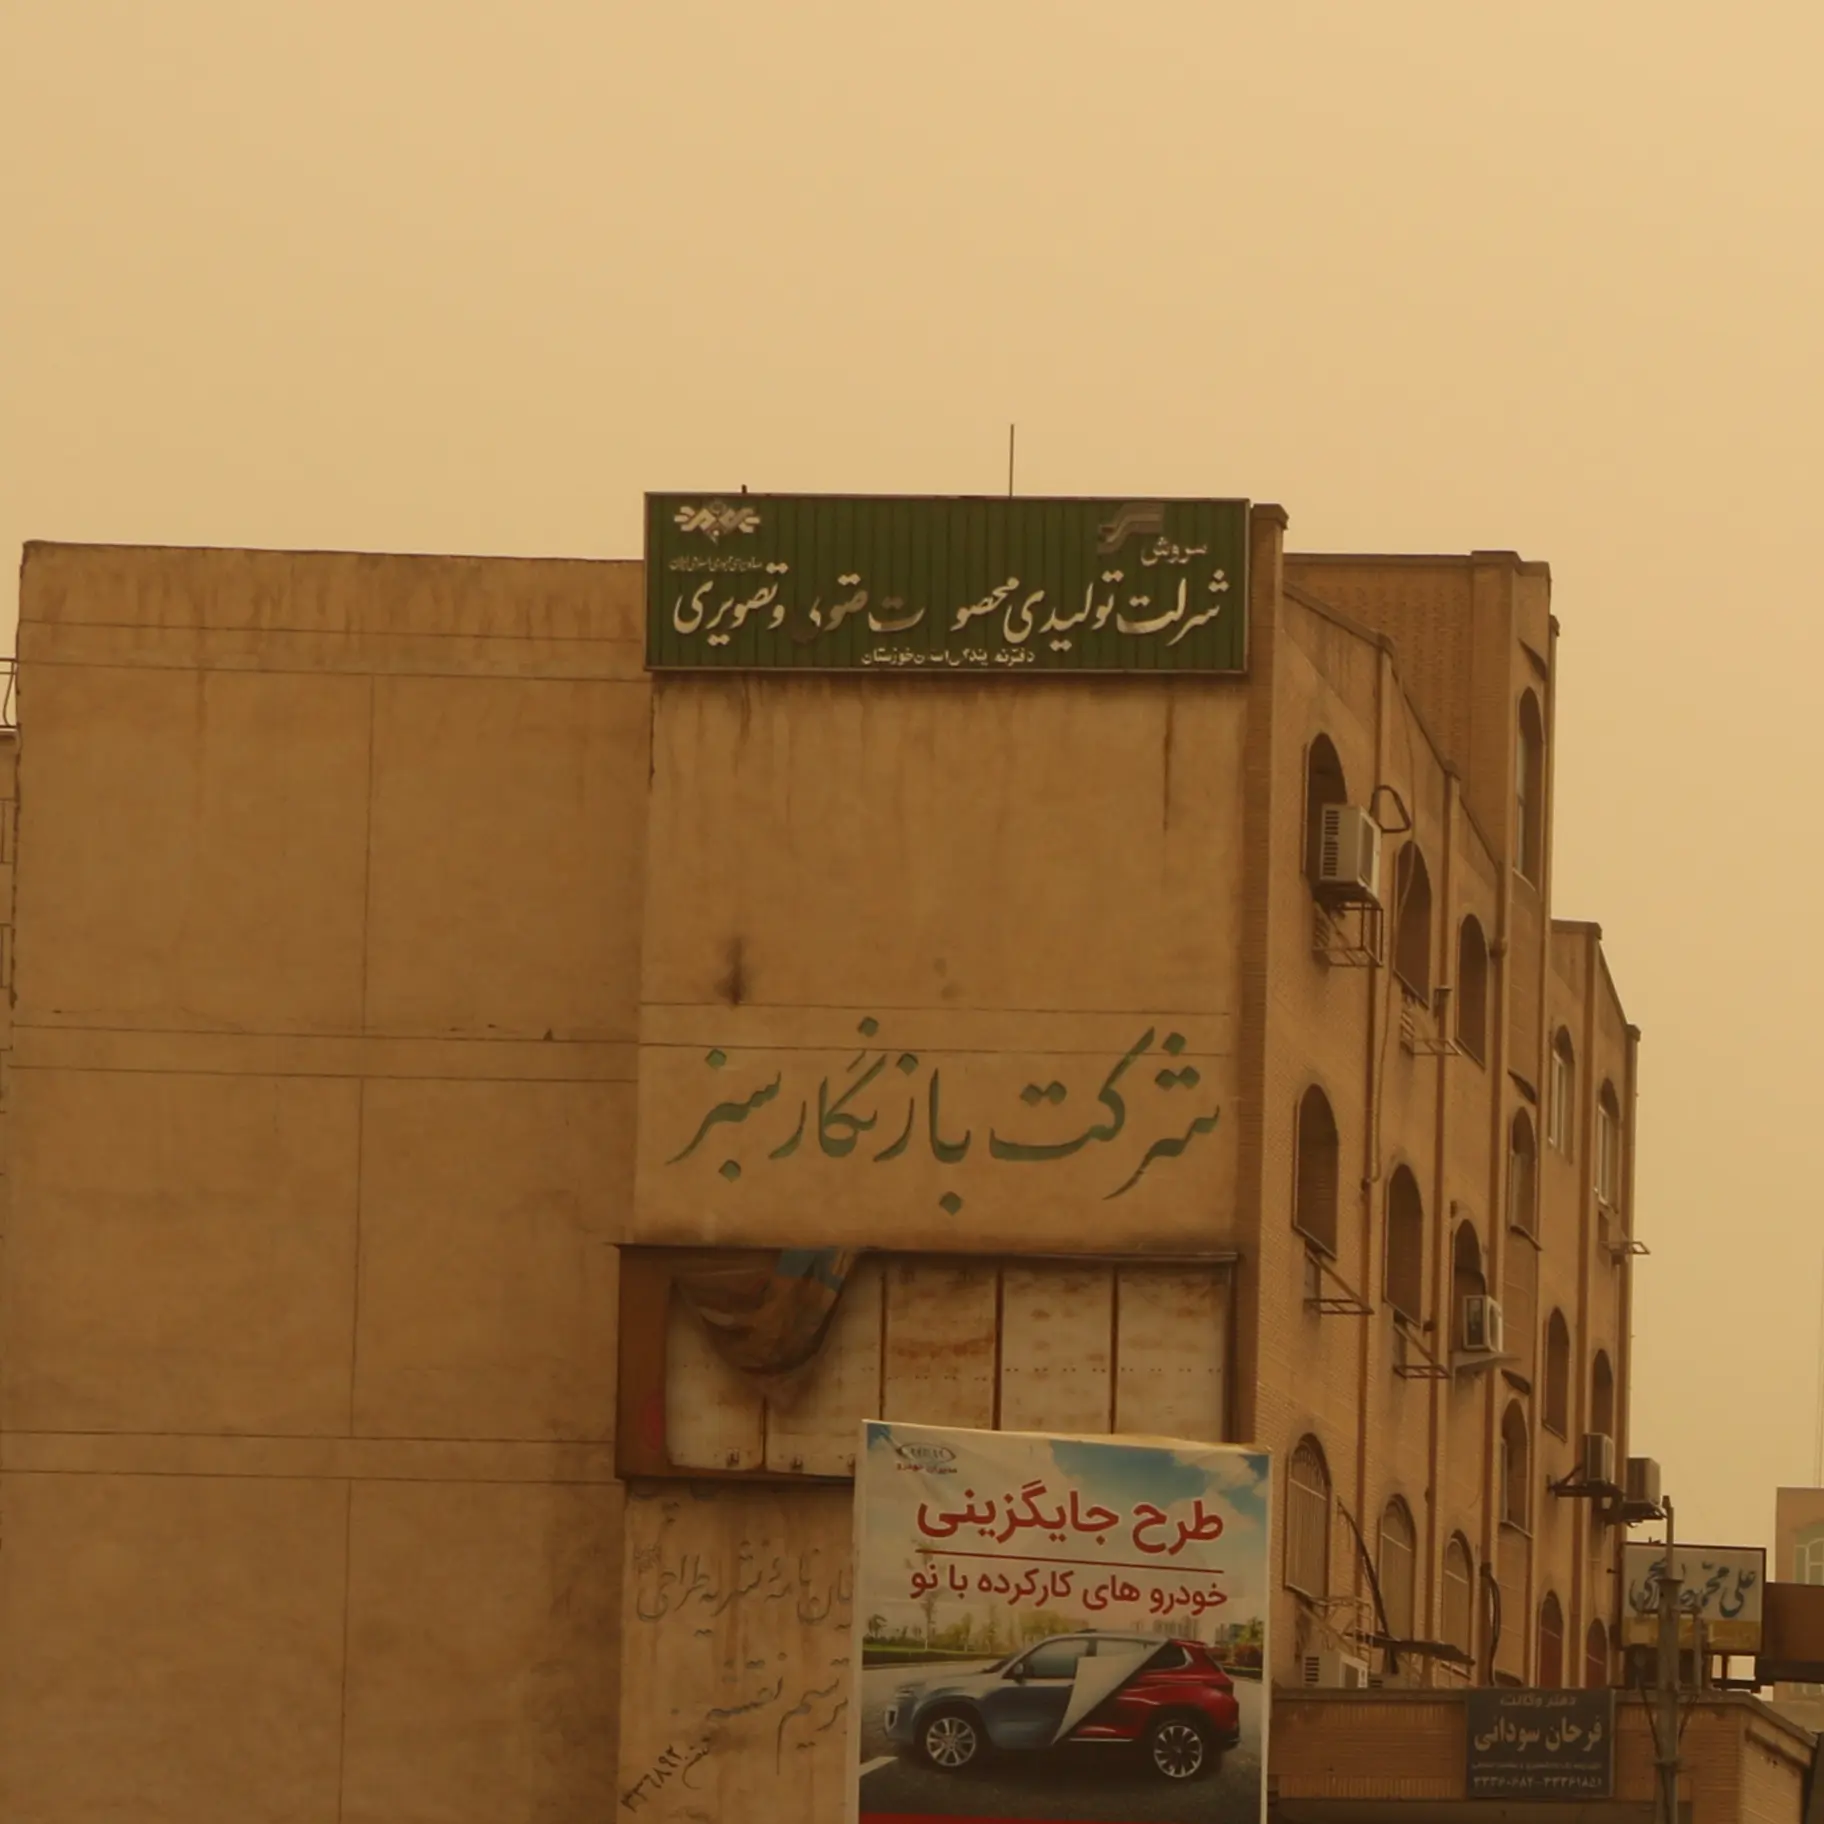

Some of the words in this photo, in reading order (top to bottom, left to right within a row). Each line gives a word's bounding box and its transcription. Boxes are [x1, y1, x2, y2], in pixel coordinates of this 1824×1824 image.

[1003, 569, 1126, 652] تولیدی
[1117, 568, 1231, 646] شرکت
[666, 1048, 782, 1182] سبز
[990, 1026, 1221, 1200] شرکت
[917, 1479, 1120, 1546] جایگزینی
[1132, 1497, 1225, 1556] طرح
[910, 1563, 939, 1600] نو
[949, 1565, 969, 1601] با
[978, 1567, 1075, 1608] کارکرده
[1083, 1574, 1140, 1611] های
[1149, 1582, 1228, 1616] خودرو
[1474, 1714, 1541, 1752] سودانی
[1545, 1715, 1603, 1752] فرحان
